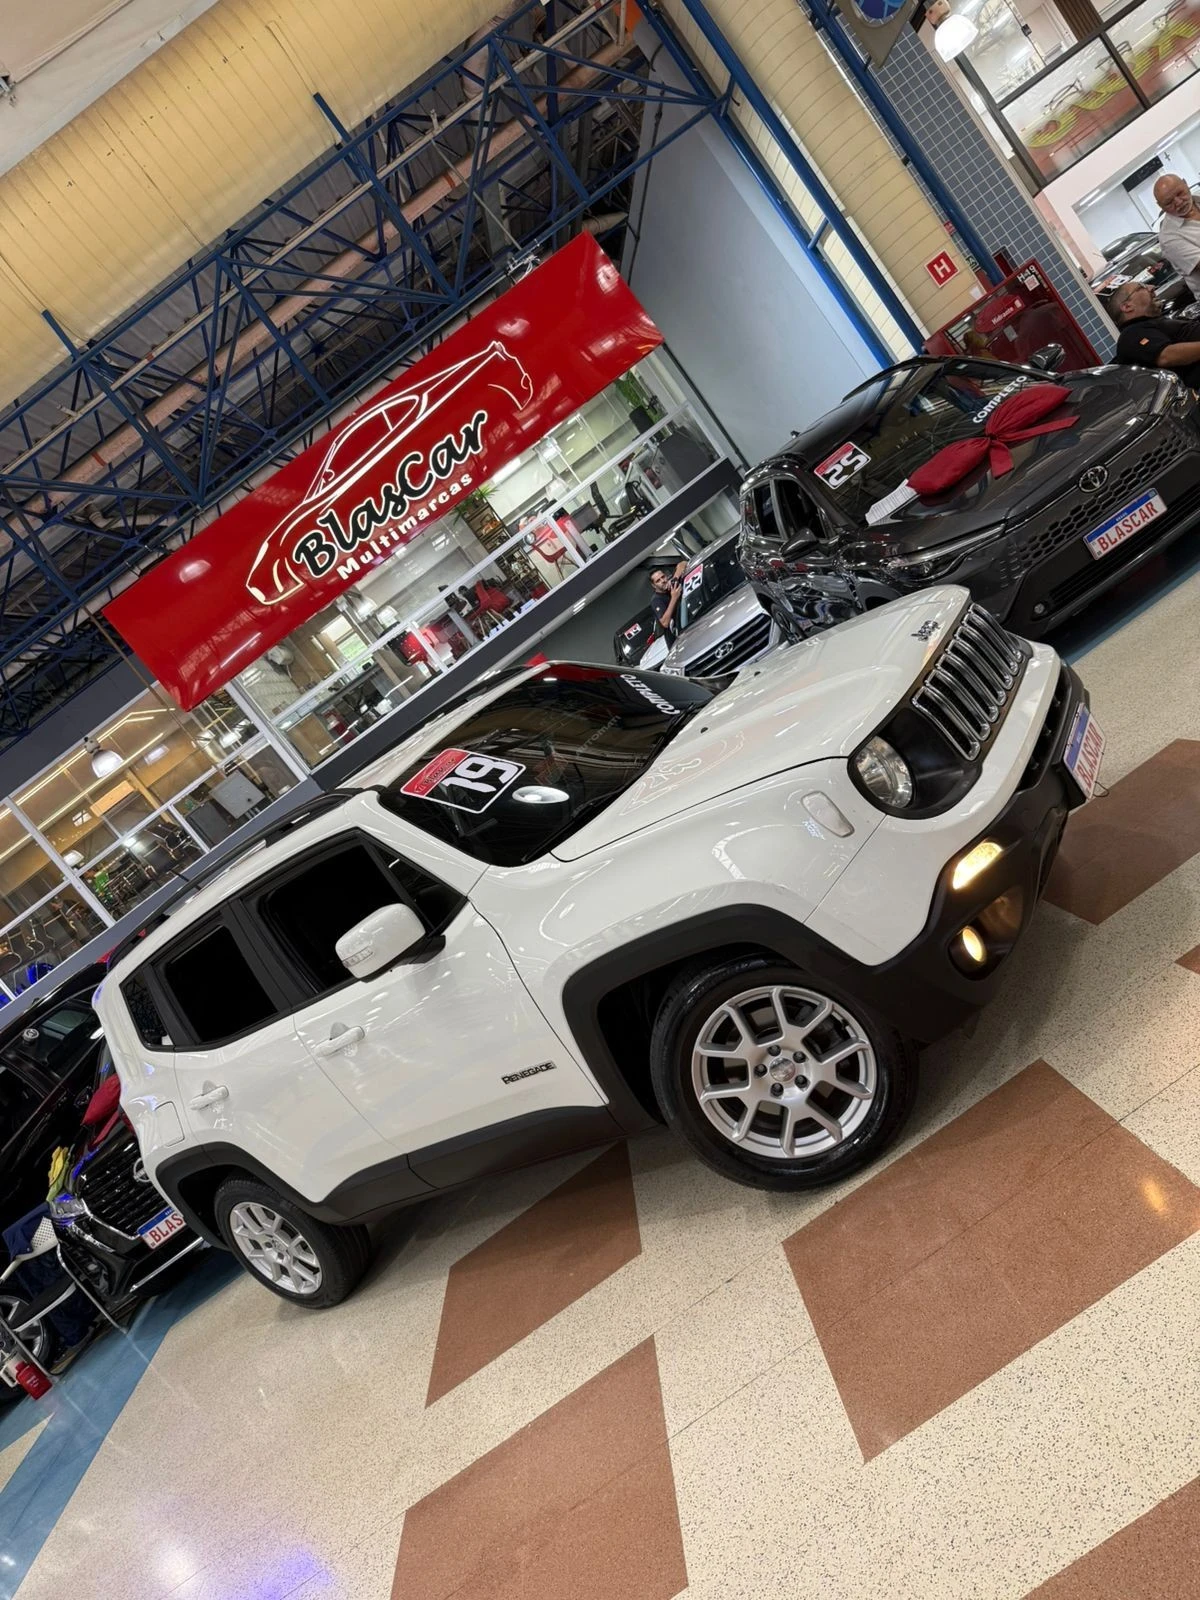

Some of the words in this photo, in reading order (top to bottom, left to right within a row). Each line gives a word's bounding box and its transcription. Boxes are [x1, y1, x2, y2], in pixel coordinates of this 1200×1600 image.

[934, 259, 951, 278] H
[973, 375, 1028, 424] COMPLETO
[824, 450, 868, 487] 25
[293, 410, 488, 577] BlasCar
[336, 473, 473, 580] Multimarcas
[1097, 501, 1158, 552] BLASCAR
[620, 673, 681, 715] COMPLETO
[441, 756, 519, 793] 19
[1077, 721, 1103, 790] BLASCAR
[501, 1062, 555, 1085] RENEGADE
[149, 1213, 183, 1243] BLAS
